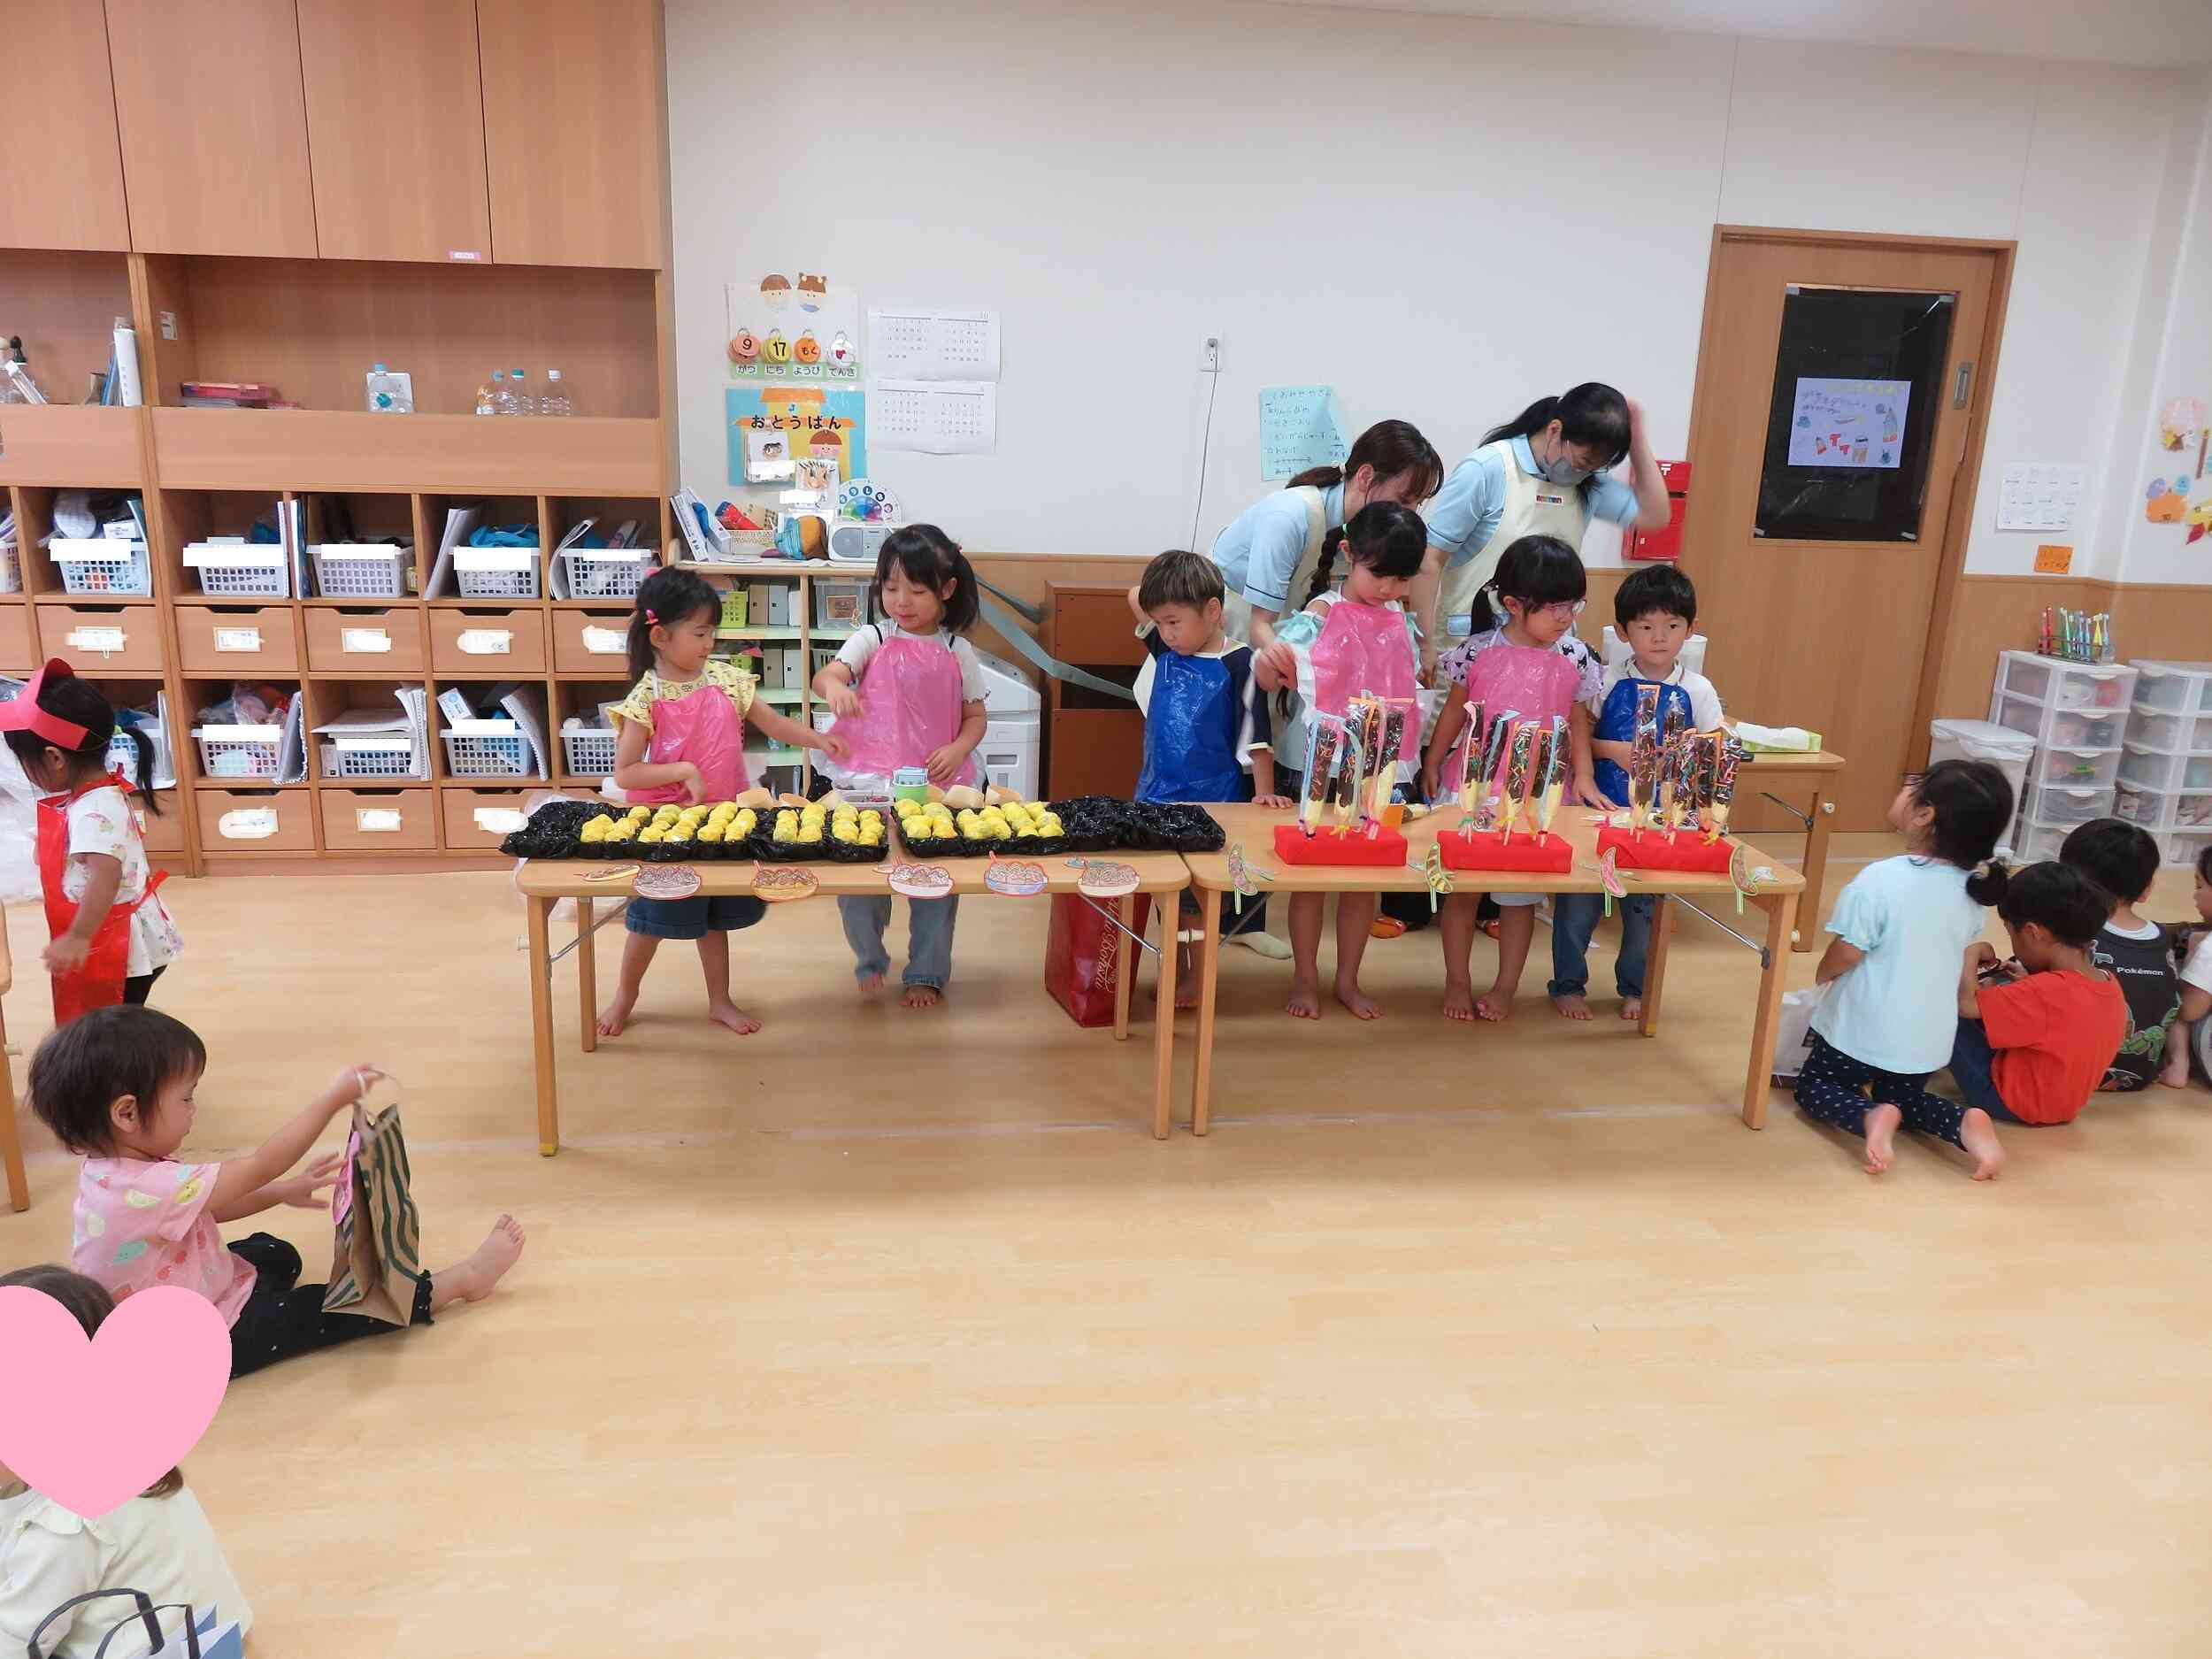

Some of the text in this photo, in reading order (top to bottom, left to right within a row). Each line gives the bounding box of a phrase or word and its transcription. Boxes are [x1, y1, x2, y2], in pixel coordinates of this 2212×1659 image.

[742, 338, 752, 349] 9
[773, 342, 787, 357] 17
[801, 346, 818, 355] もく
[737, 365, 757, 373] がつ
[766, 365, 784, 374] にち
[794, 365, 820, 375] ようび
[829, 367, 856, 377] てんき
[751, 414, 841, 430] おとうばん
[2116, 966, 2164, 976] Pokémon
